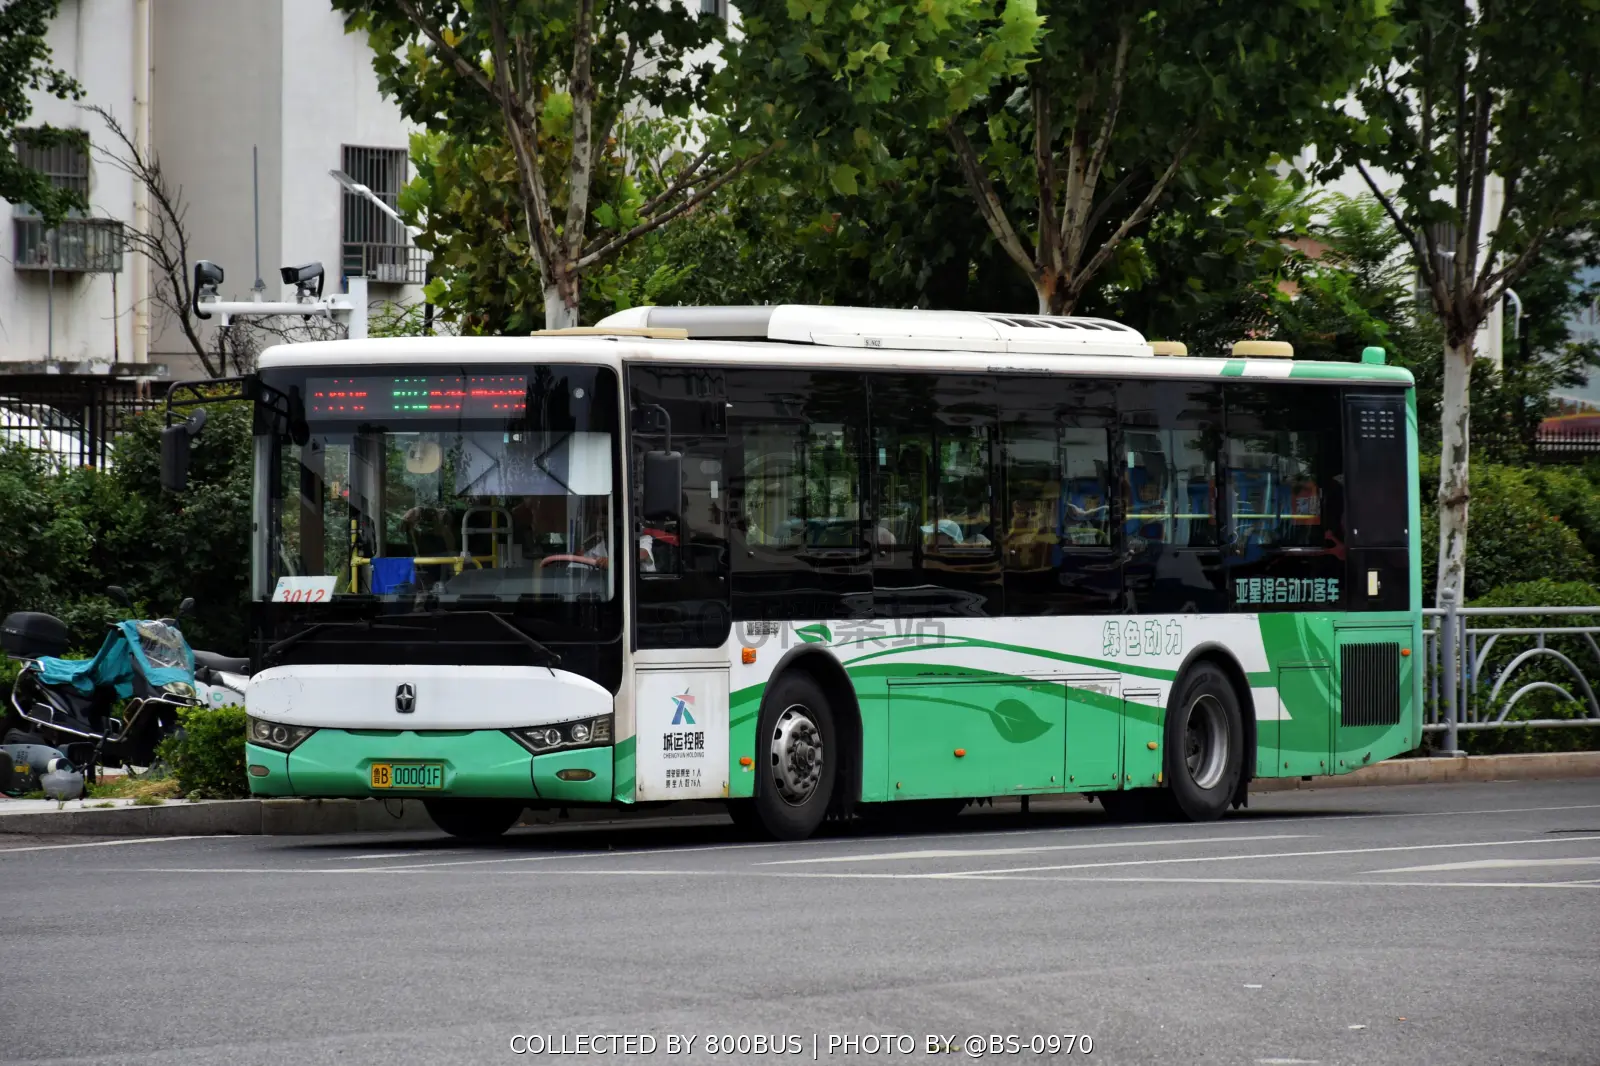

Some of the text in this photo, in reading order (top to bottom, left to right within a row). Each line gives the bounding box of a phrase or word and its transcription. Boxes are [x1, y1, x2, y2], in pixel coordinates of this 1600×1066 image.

[282, 589, 325, 602] 3012
[1236, 578, 1339, 603] 亚星混合动力客车
[1103, 619, 1182, 656] 绿色动力
[663, 731, 704, 751] 城运控股
